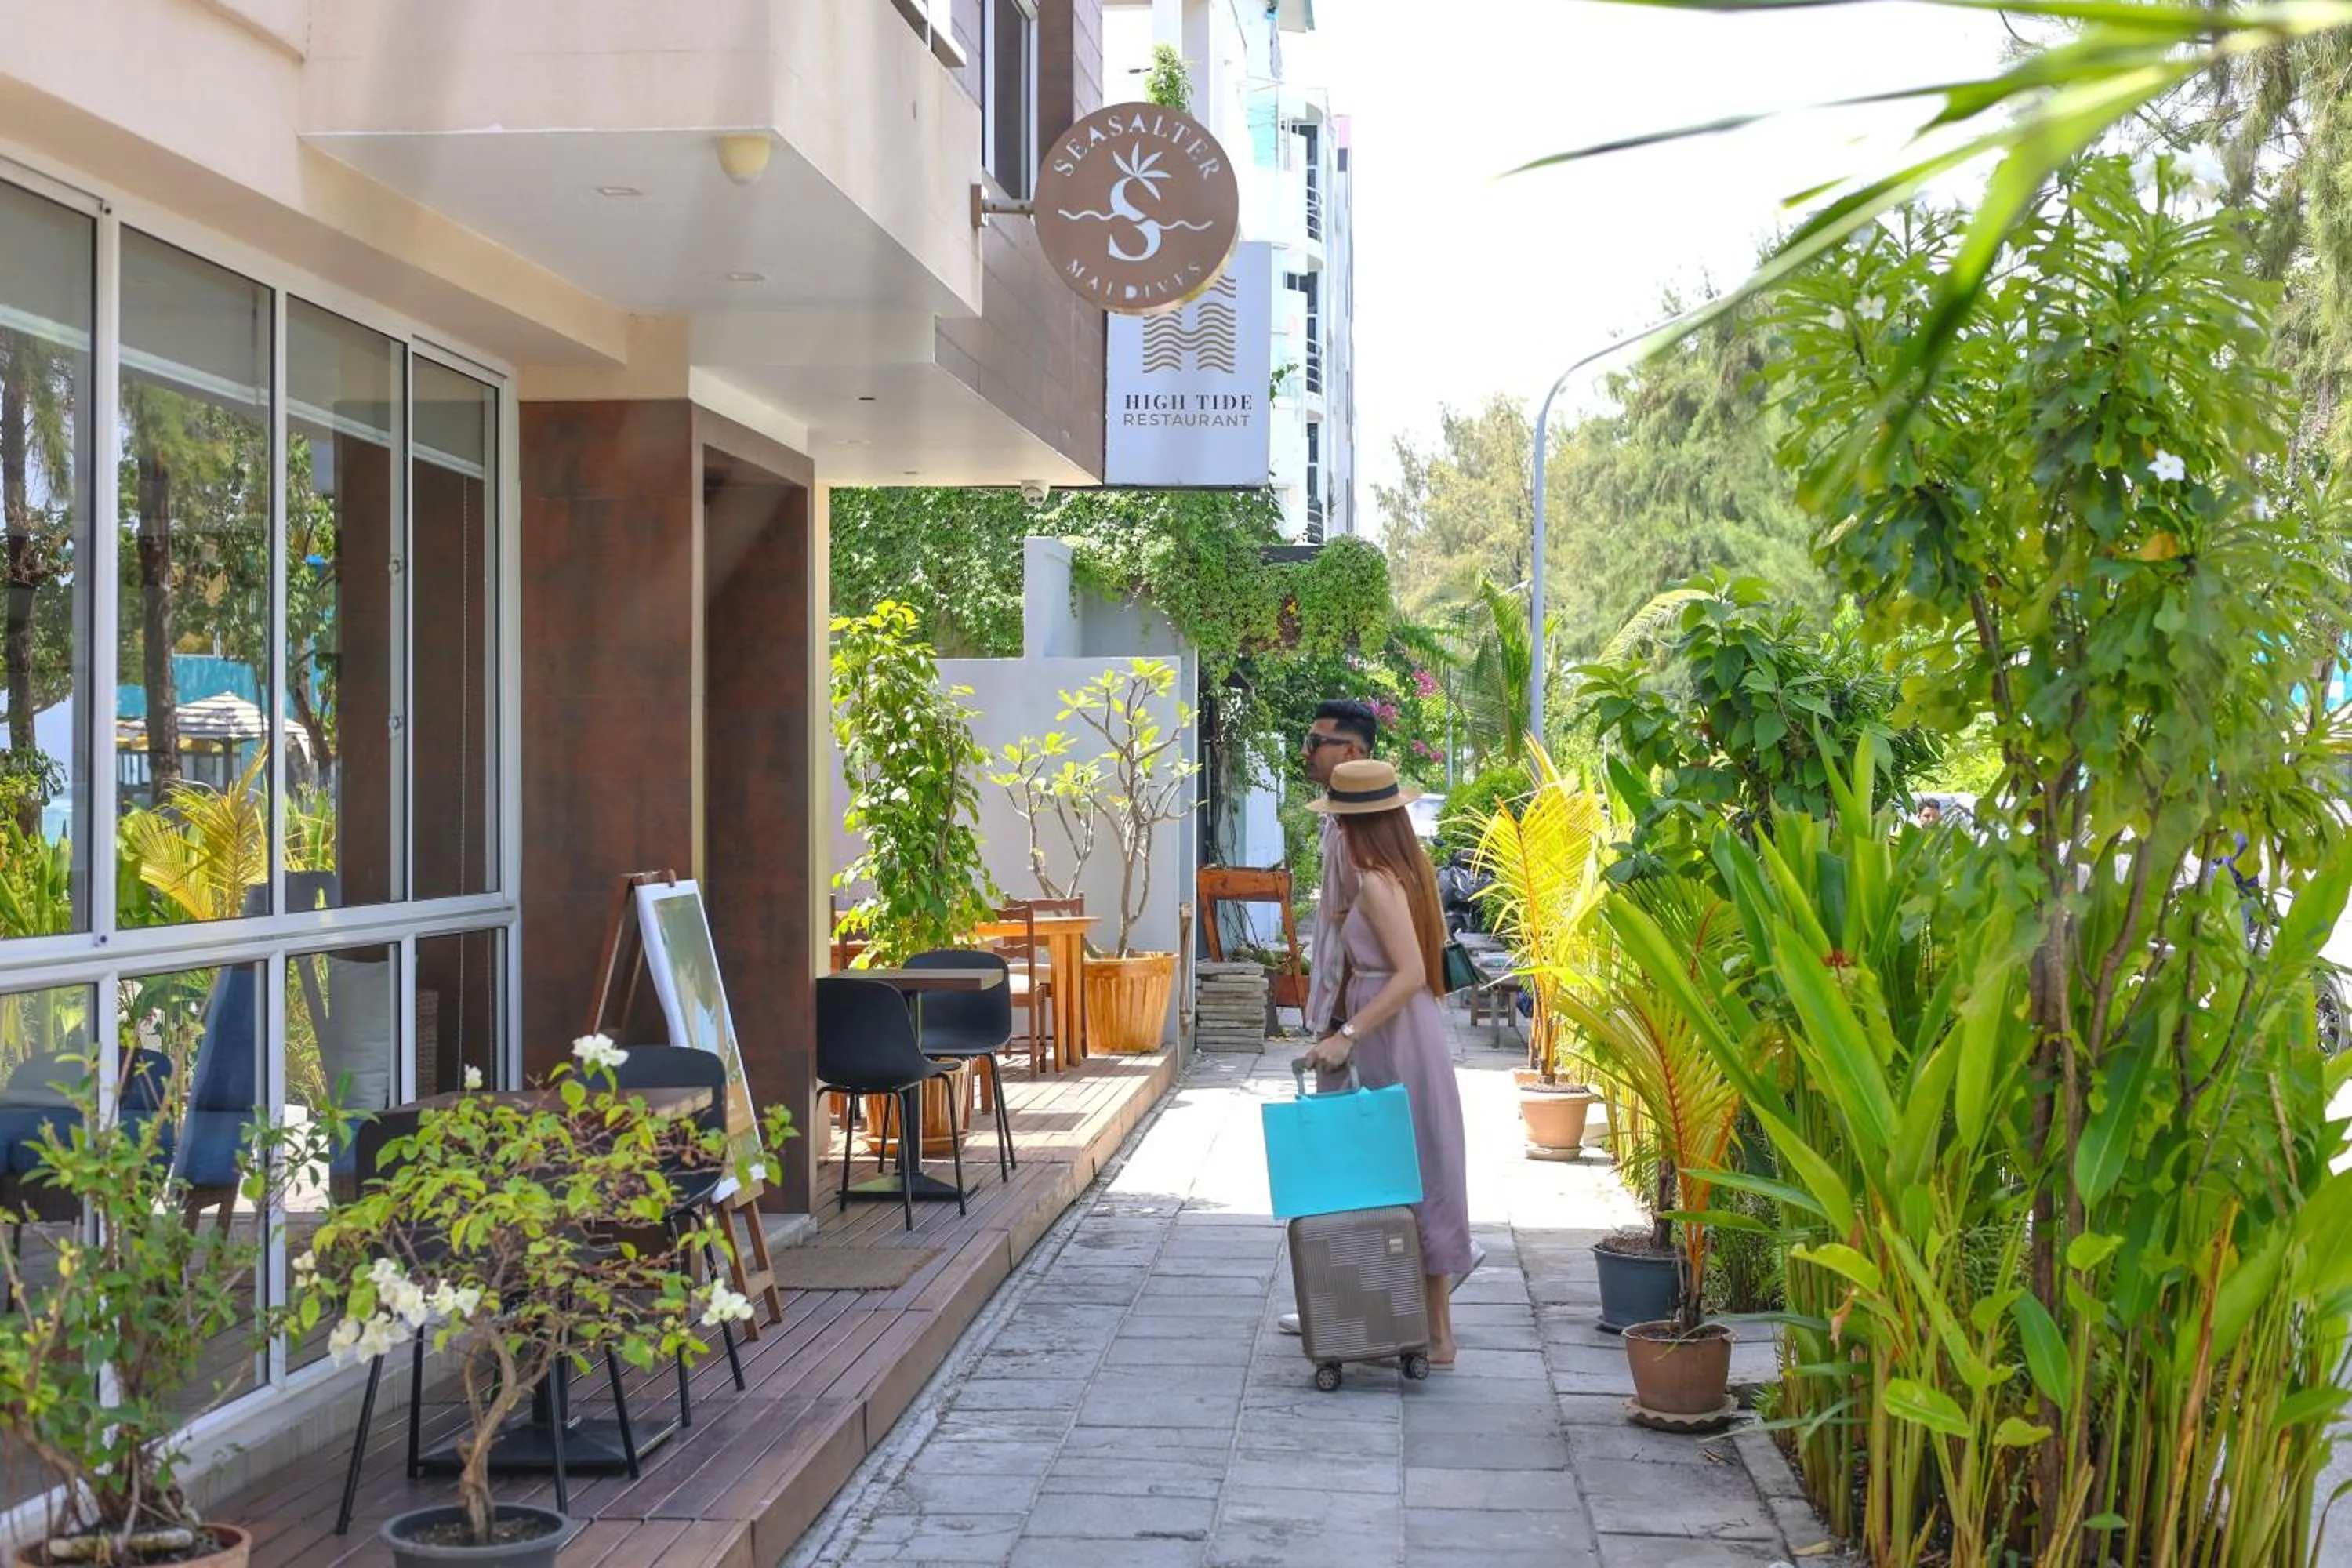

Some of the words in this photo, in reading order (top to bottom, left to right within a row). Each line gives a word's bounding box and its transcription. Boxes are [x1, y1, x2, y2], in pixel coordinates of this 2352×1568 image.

[1053, 113, 1220, 180] SEASALTER
[1125, 394, 1185, 410] HIGH
[1196, 394, 1252, 410] TIDE
[1123, 413, 1250, 426] RESTAURANT
